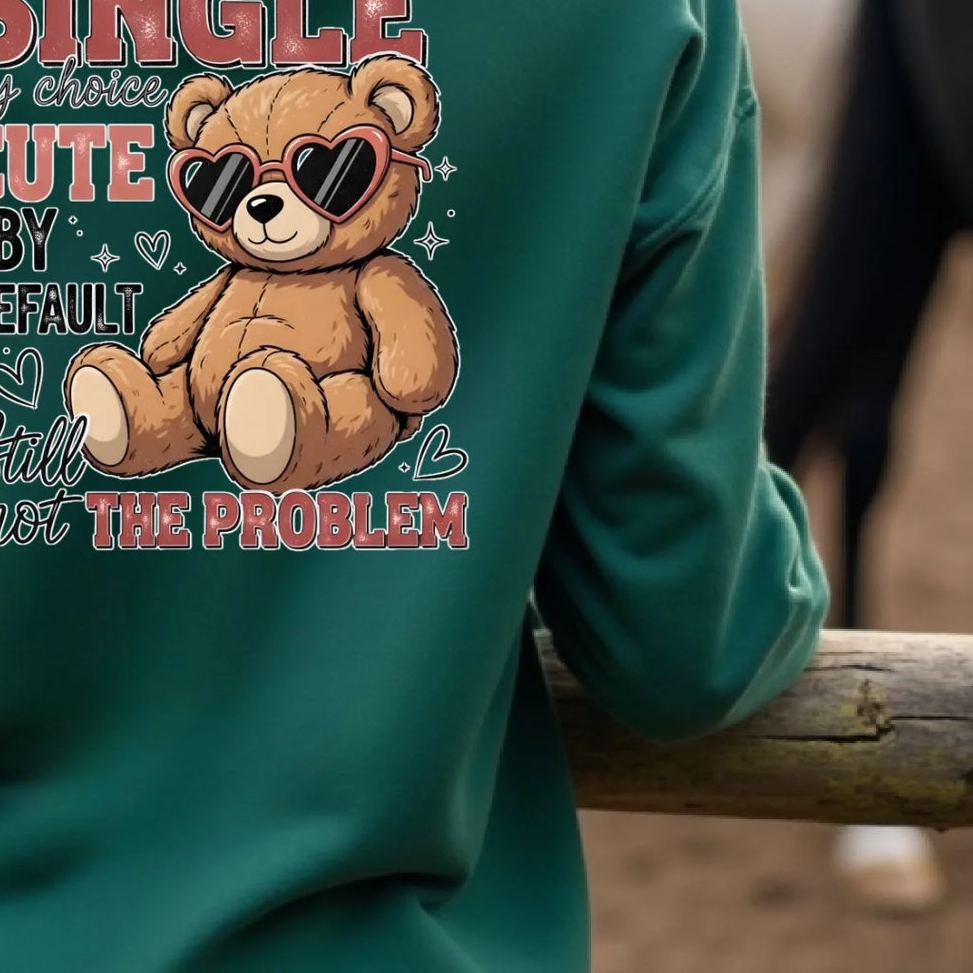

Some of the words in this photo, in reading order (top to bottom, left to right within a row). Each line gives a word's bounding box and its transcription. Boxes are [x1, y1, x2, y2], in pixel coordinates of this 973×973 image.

[33, 55, 167, 108] choice
[84, 491, 192, 549] THE
[202, 491, 469, 550] PROBLEM
